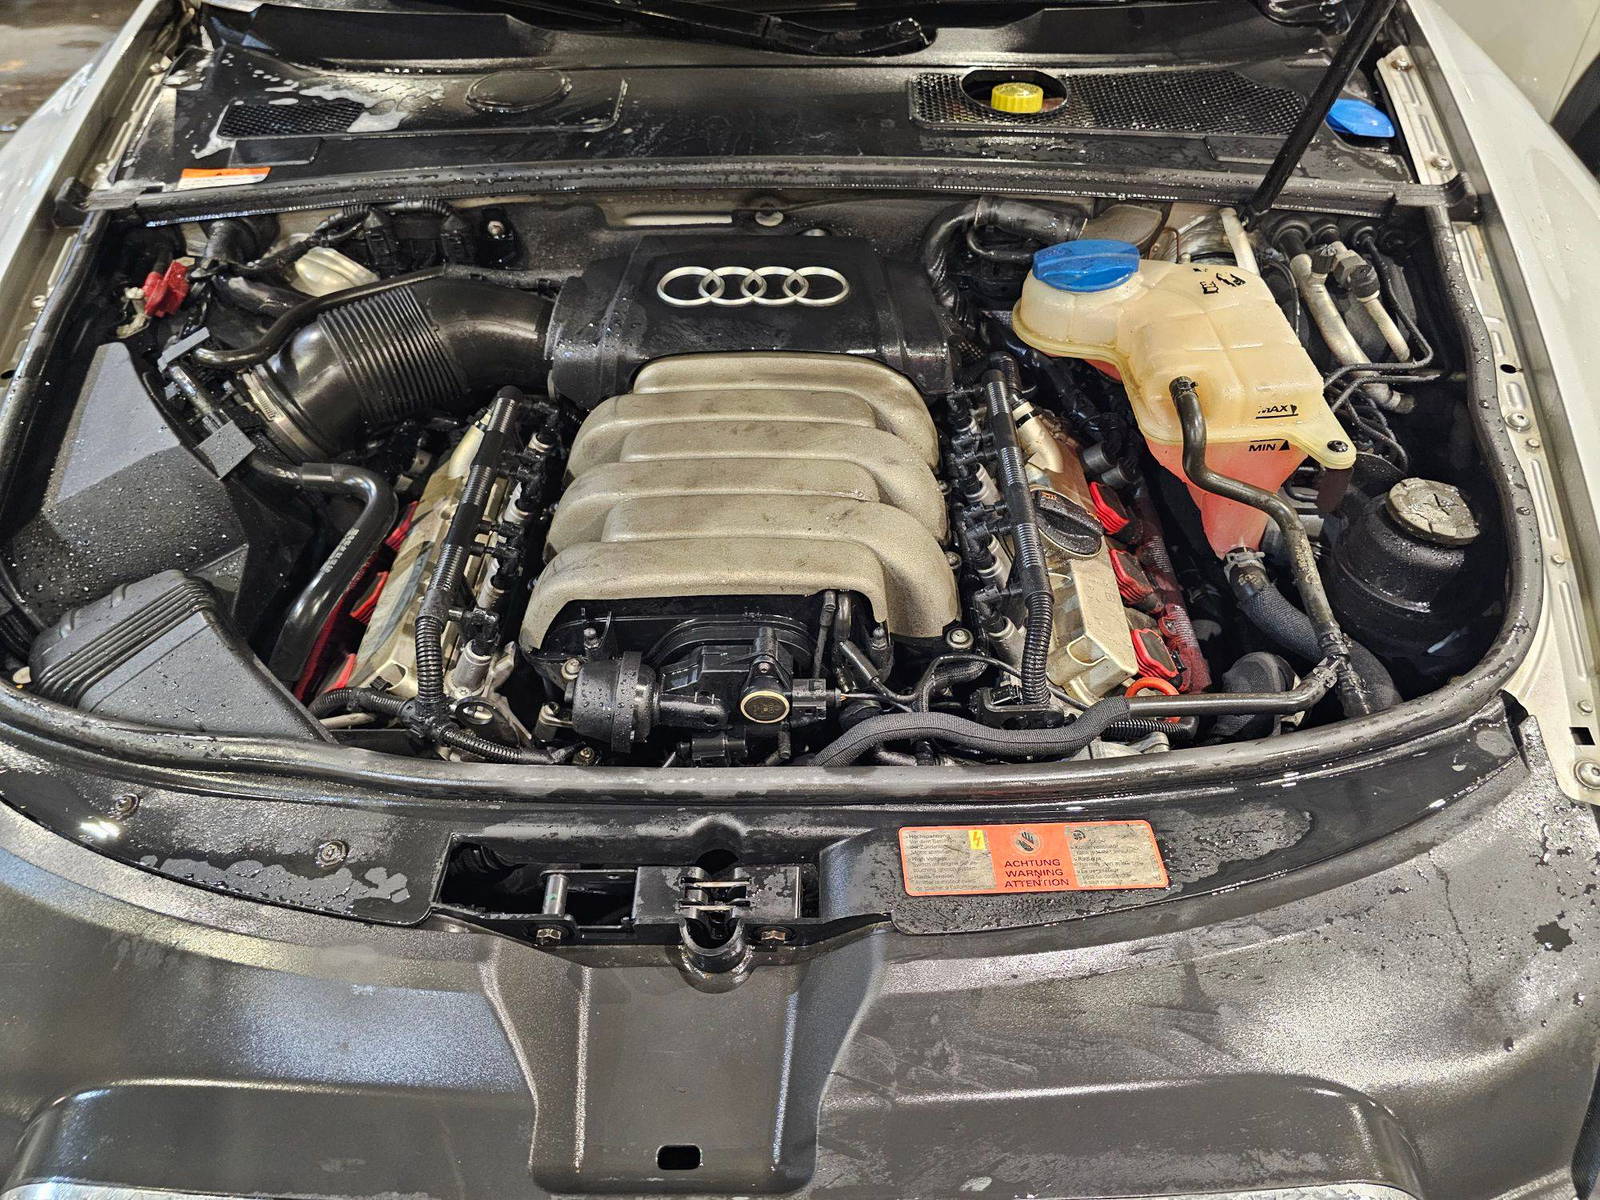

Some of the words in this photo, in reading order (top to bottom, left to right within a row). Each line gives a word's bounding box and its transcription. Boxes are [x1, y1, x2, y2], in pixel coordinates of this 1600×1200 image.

[1248, 443, 1277, 452] MIN
[1004, 858, 1061, 868] ACHTUNG
[1005, 868, 1064, 878] WARNING
[1004, 878, 1070, 888] ATTENTION
